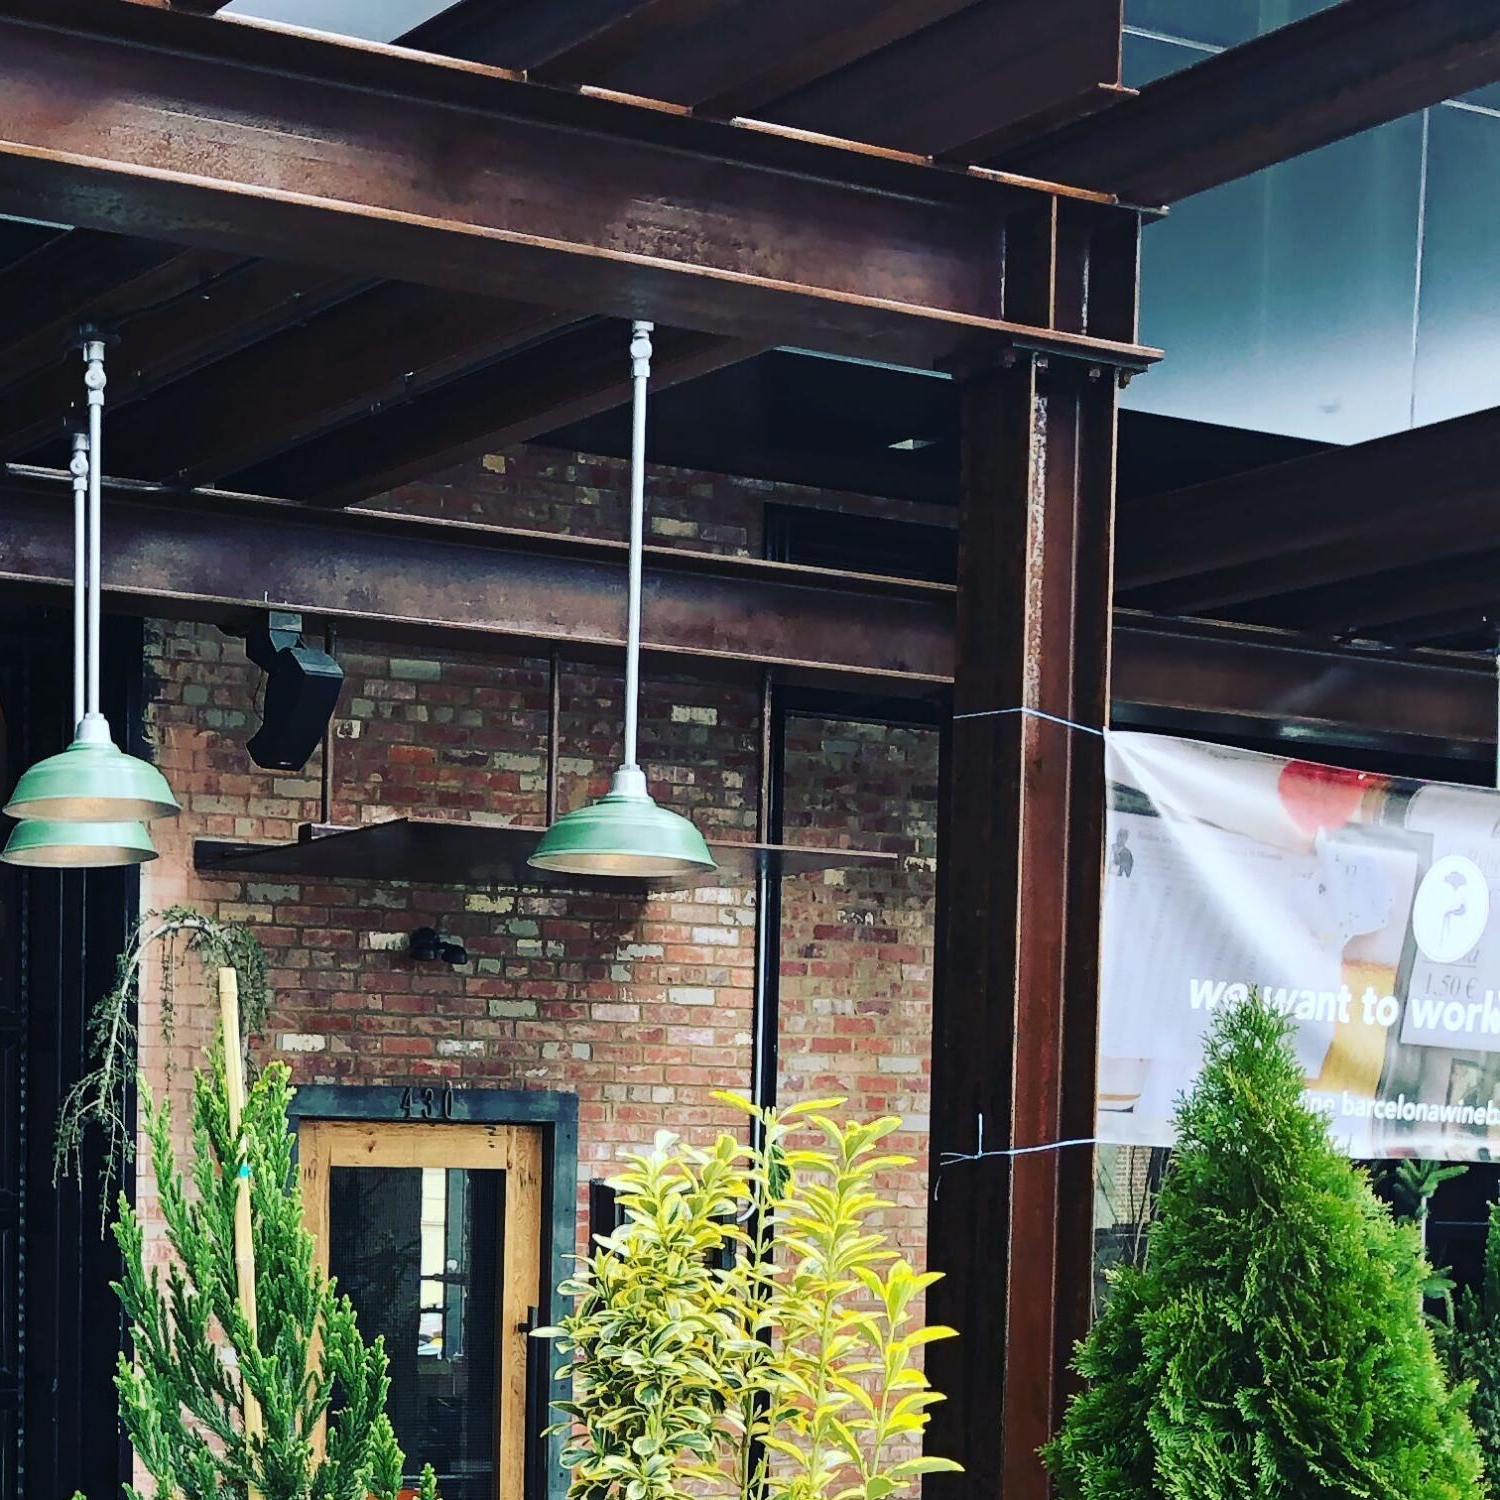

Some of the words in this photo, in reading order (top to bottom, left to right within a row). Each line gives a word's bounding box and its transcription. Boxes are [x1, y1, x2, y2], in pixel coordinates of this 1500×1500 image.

[1263, 984, 1353, 1024] want
[1362, 986, 1400, 1027] to
[1411, 989, 1500, 1035] work
[400, 1086, 454, 1120] 430
